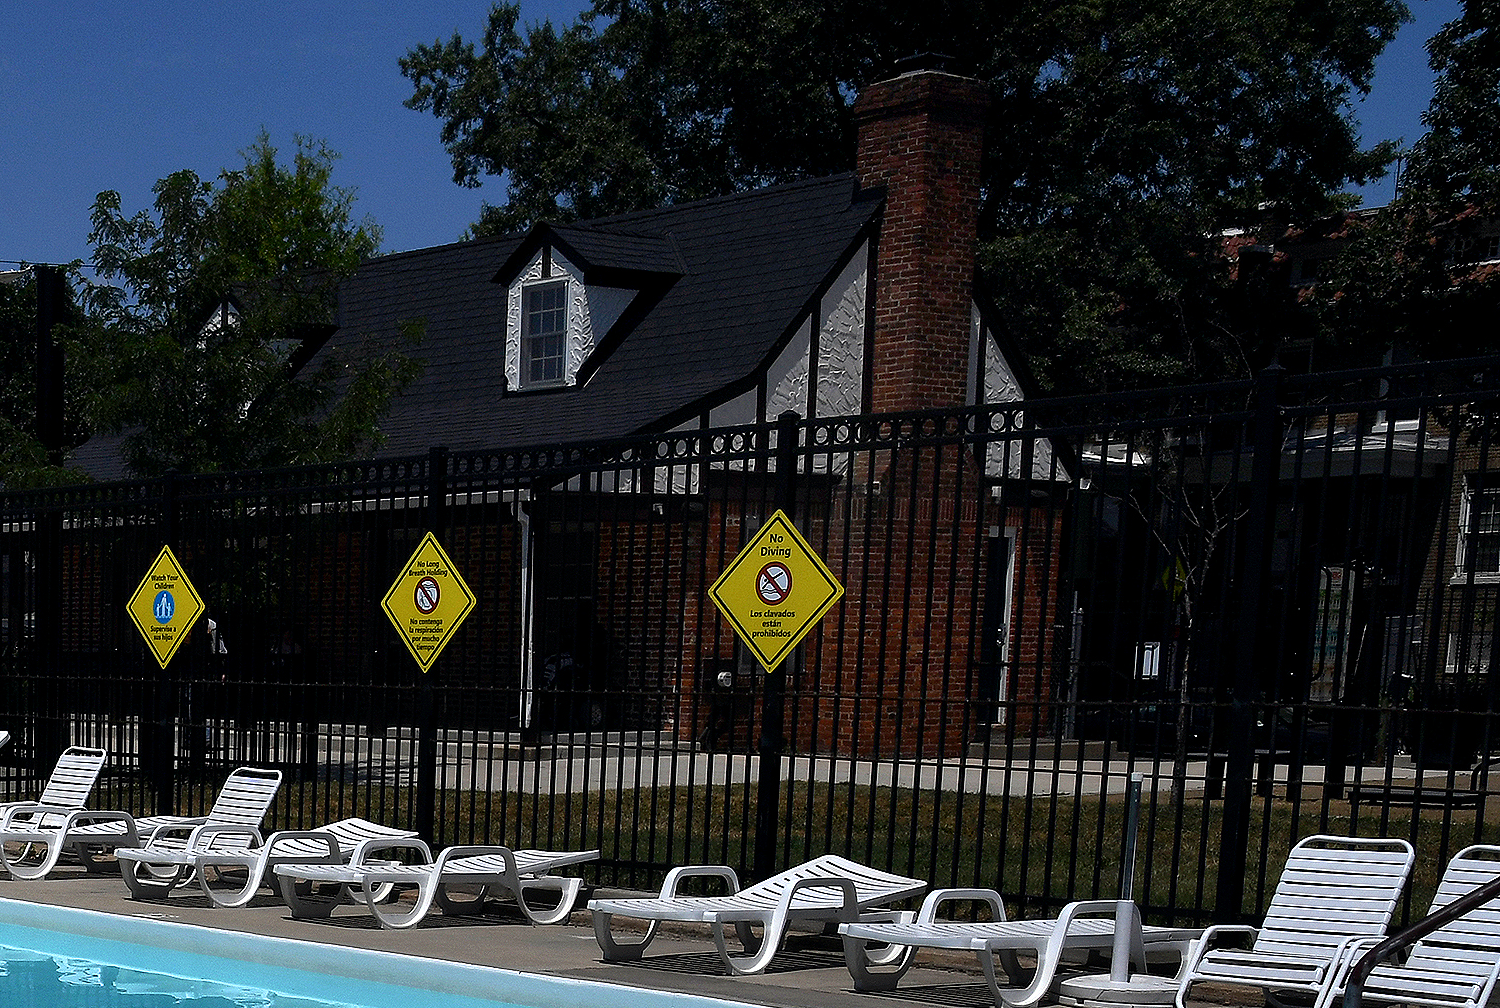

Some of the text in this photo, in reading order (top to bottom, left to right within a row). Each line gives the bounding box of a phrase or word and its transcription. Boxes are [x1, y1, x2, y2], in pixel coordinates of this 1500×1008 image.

[770, 534, 783, 542] No
[761, 547, 791, 558] Diving
[427, 569, 447, 577] Holding
[752, 630, 791, 638] prohibidos
